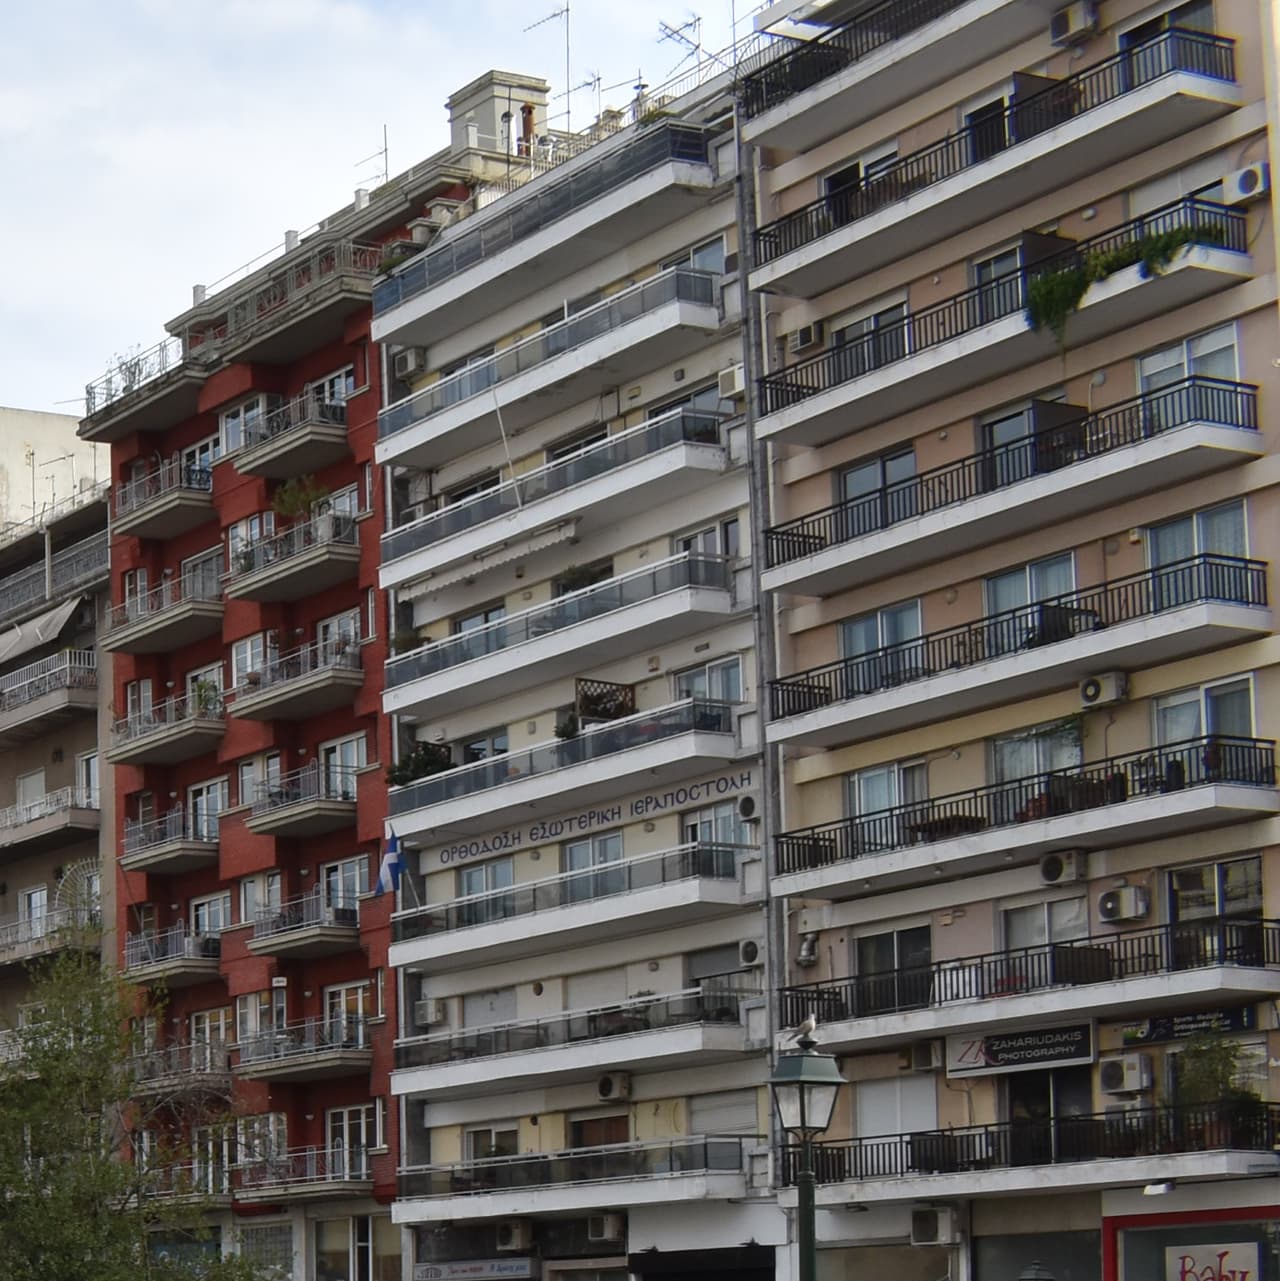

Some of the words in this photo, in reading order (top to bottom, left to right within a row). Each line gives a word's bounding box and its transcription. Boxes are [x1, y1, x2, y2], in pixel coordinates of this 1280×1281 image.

[440, 831, 521, 864] ΟΡΘΟΔΟΞΗ
[529, 805, 622, 842] ΕΞΩΤΕΡΙΚΗ
[998, 1045, 1076, 1061] PHOTOGRAPHY
